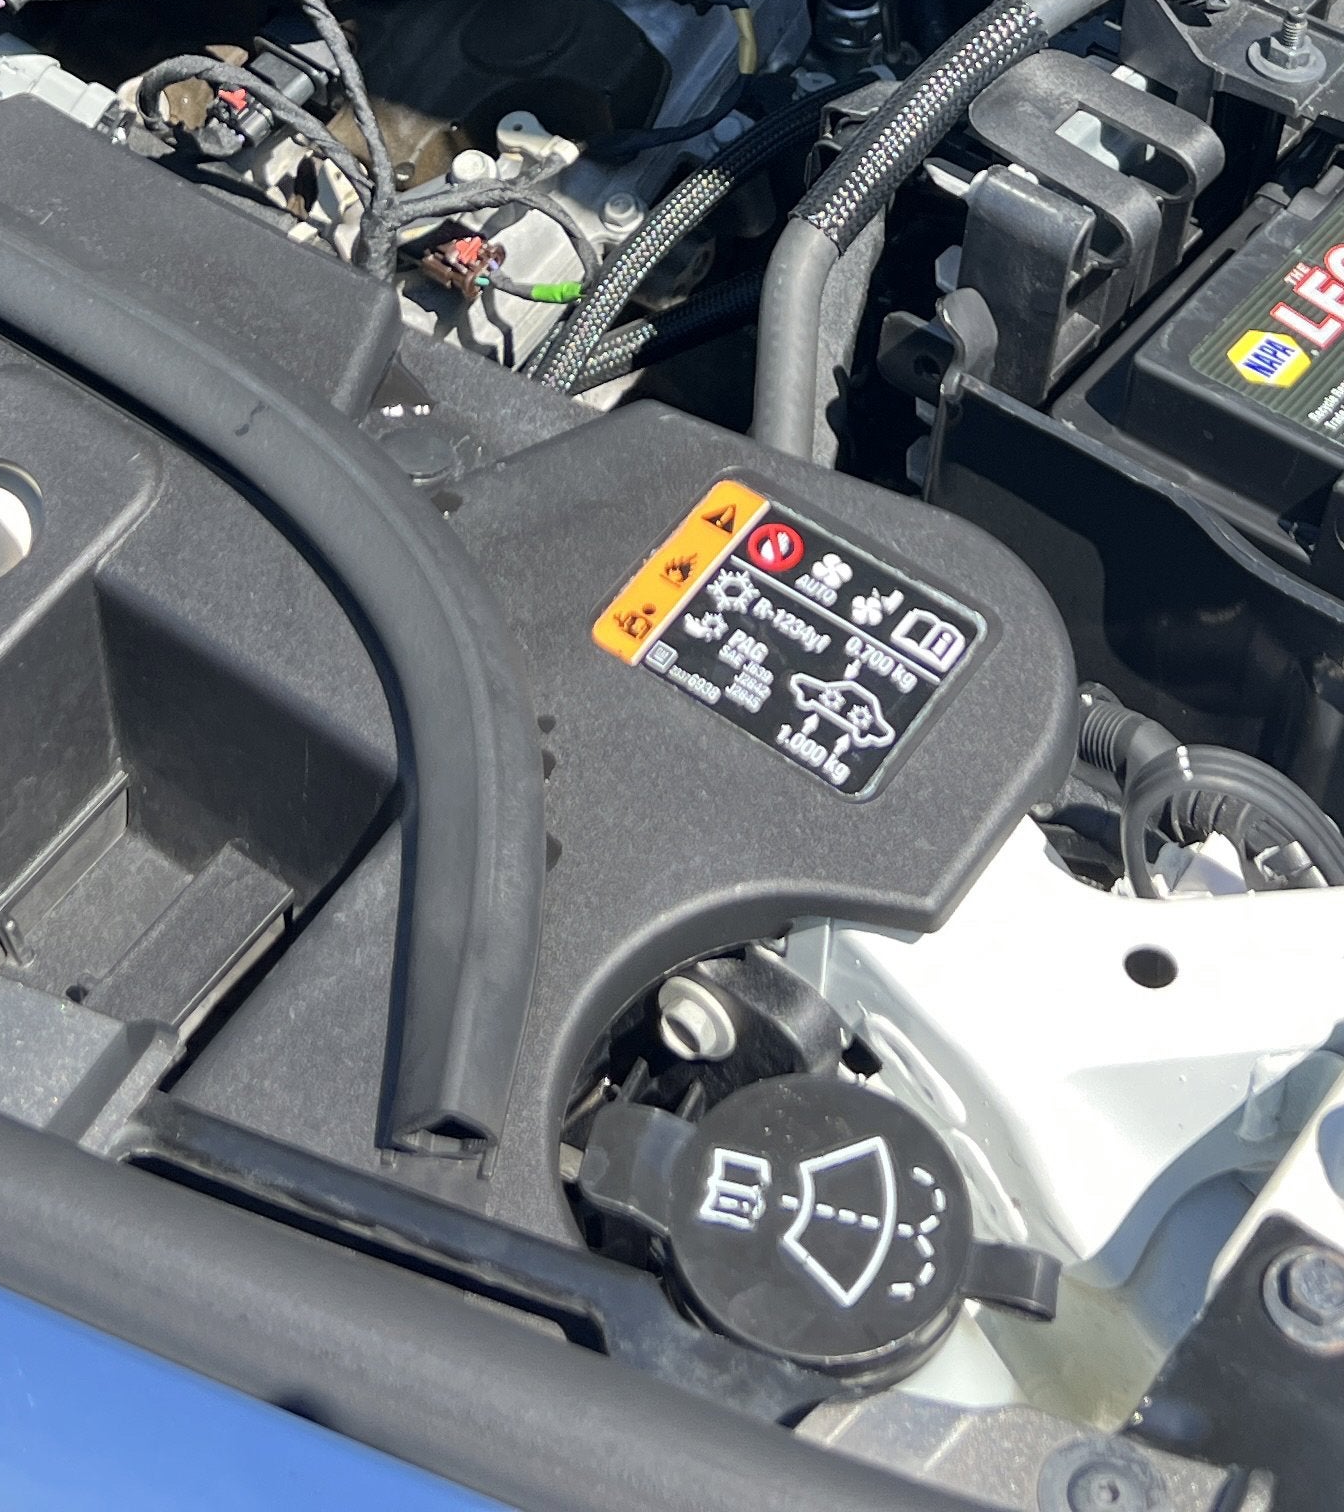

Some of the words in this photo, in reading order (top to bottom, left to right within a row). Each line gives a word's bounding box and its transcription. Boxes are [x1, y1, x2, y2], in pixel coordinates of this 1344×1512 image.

[1284, 262, 1311, 286] THE
[1243, 339, 1295, 378] NAPA
[1308, 395, 1339, 423] Recycle
[795, 574, 838, 607] AUTO
[752, 597, 831, 654] R-1234yf
[718, 644, 745, 670] SAE
[727, 629, 769, 664] PAG
[844, 636, 895, 677] 0.700
[890, 663, 917, 694] kg
[776, 724, 827, 768] 1.000
[822, 753, 851, 785] kg
